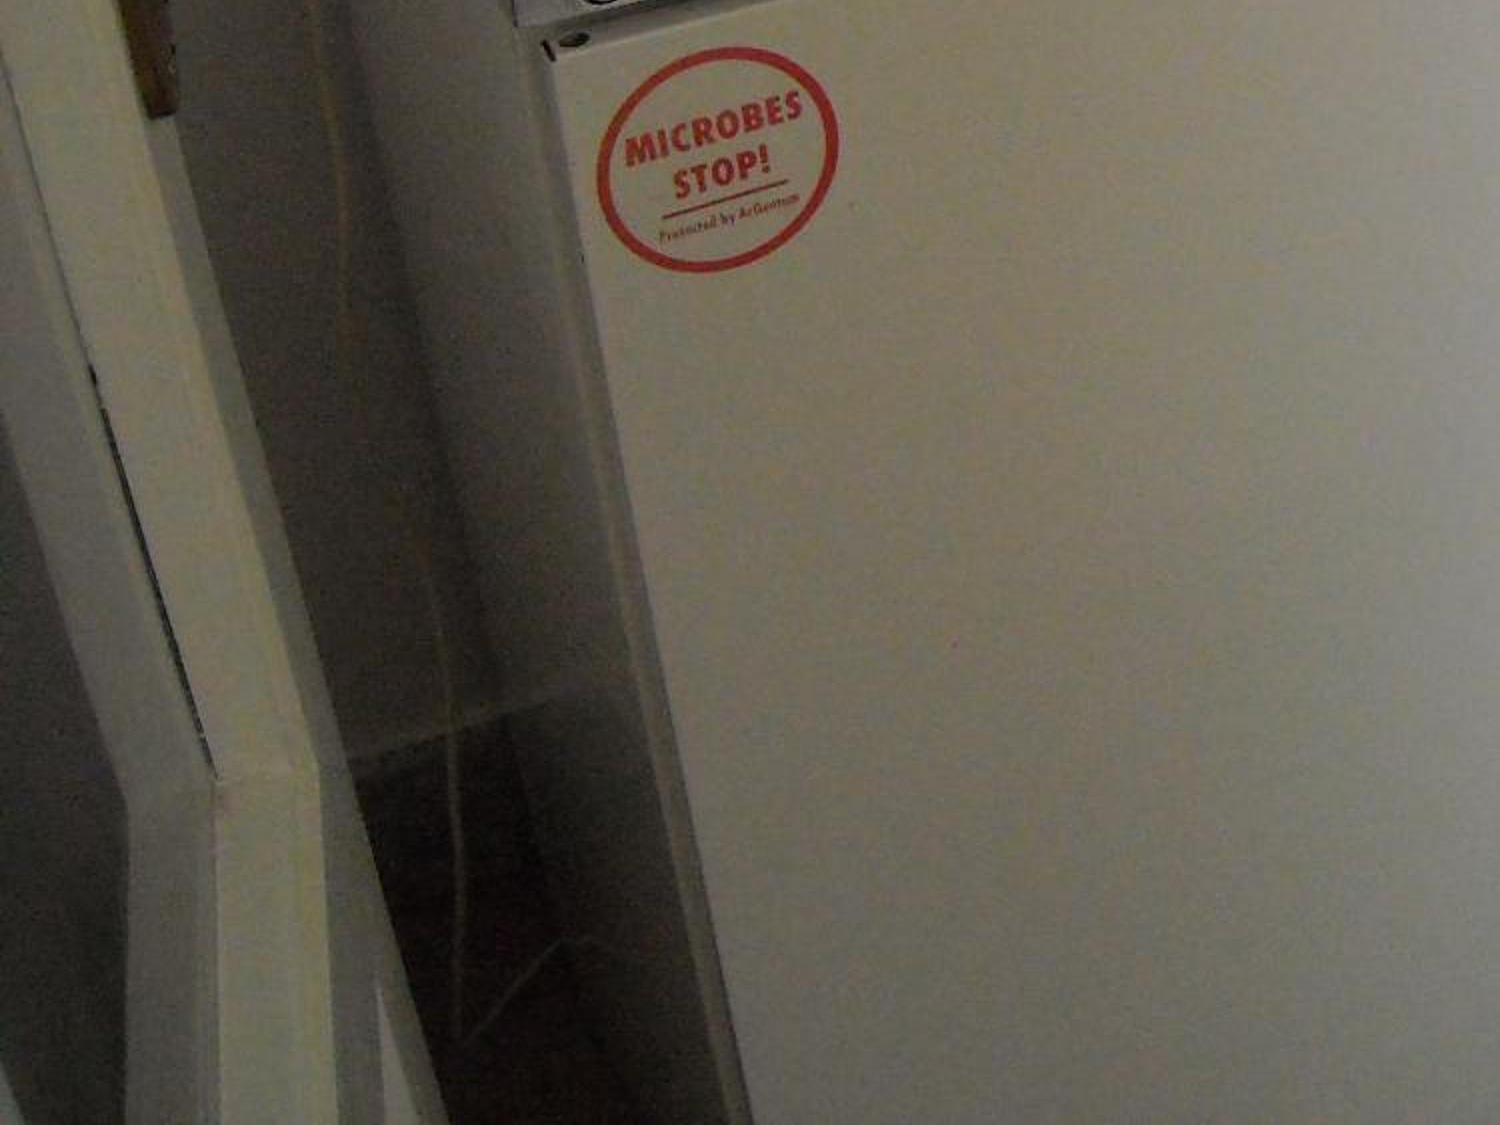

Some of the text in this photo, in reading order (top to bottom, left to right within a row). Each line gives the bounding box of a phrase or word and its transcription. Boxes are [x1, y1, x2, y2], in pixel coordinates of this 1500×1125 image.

[624, 90, 804, 167] MICROBES
[672, 143, 770, 200] STOP!
[719, 212, 736, 229] by
